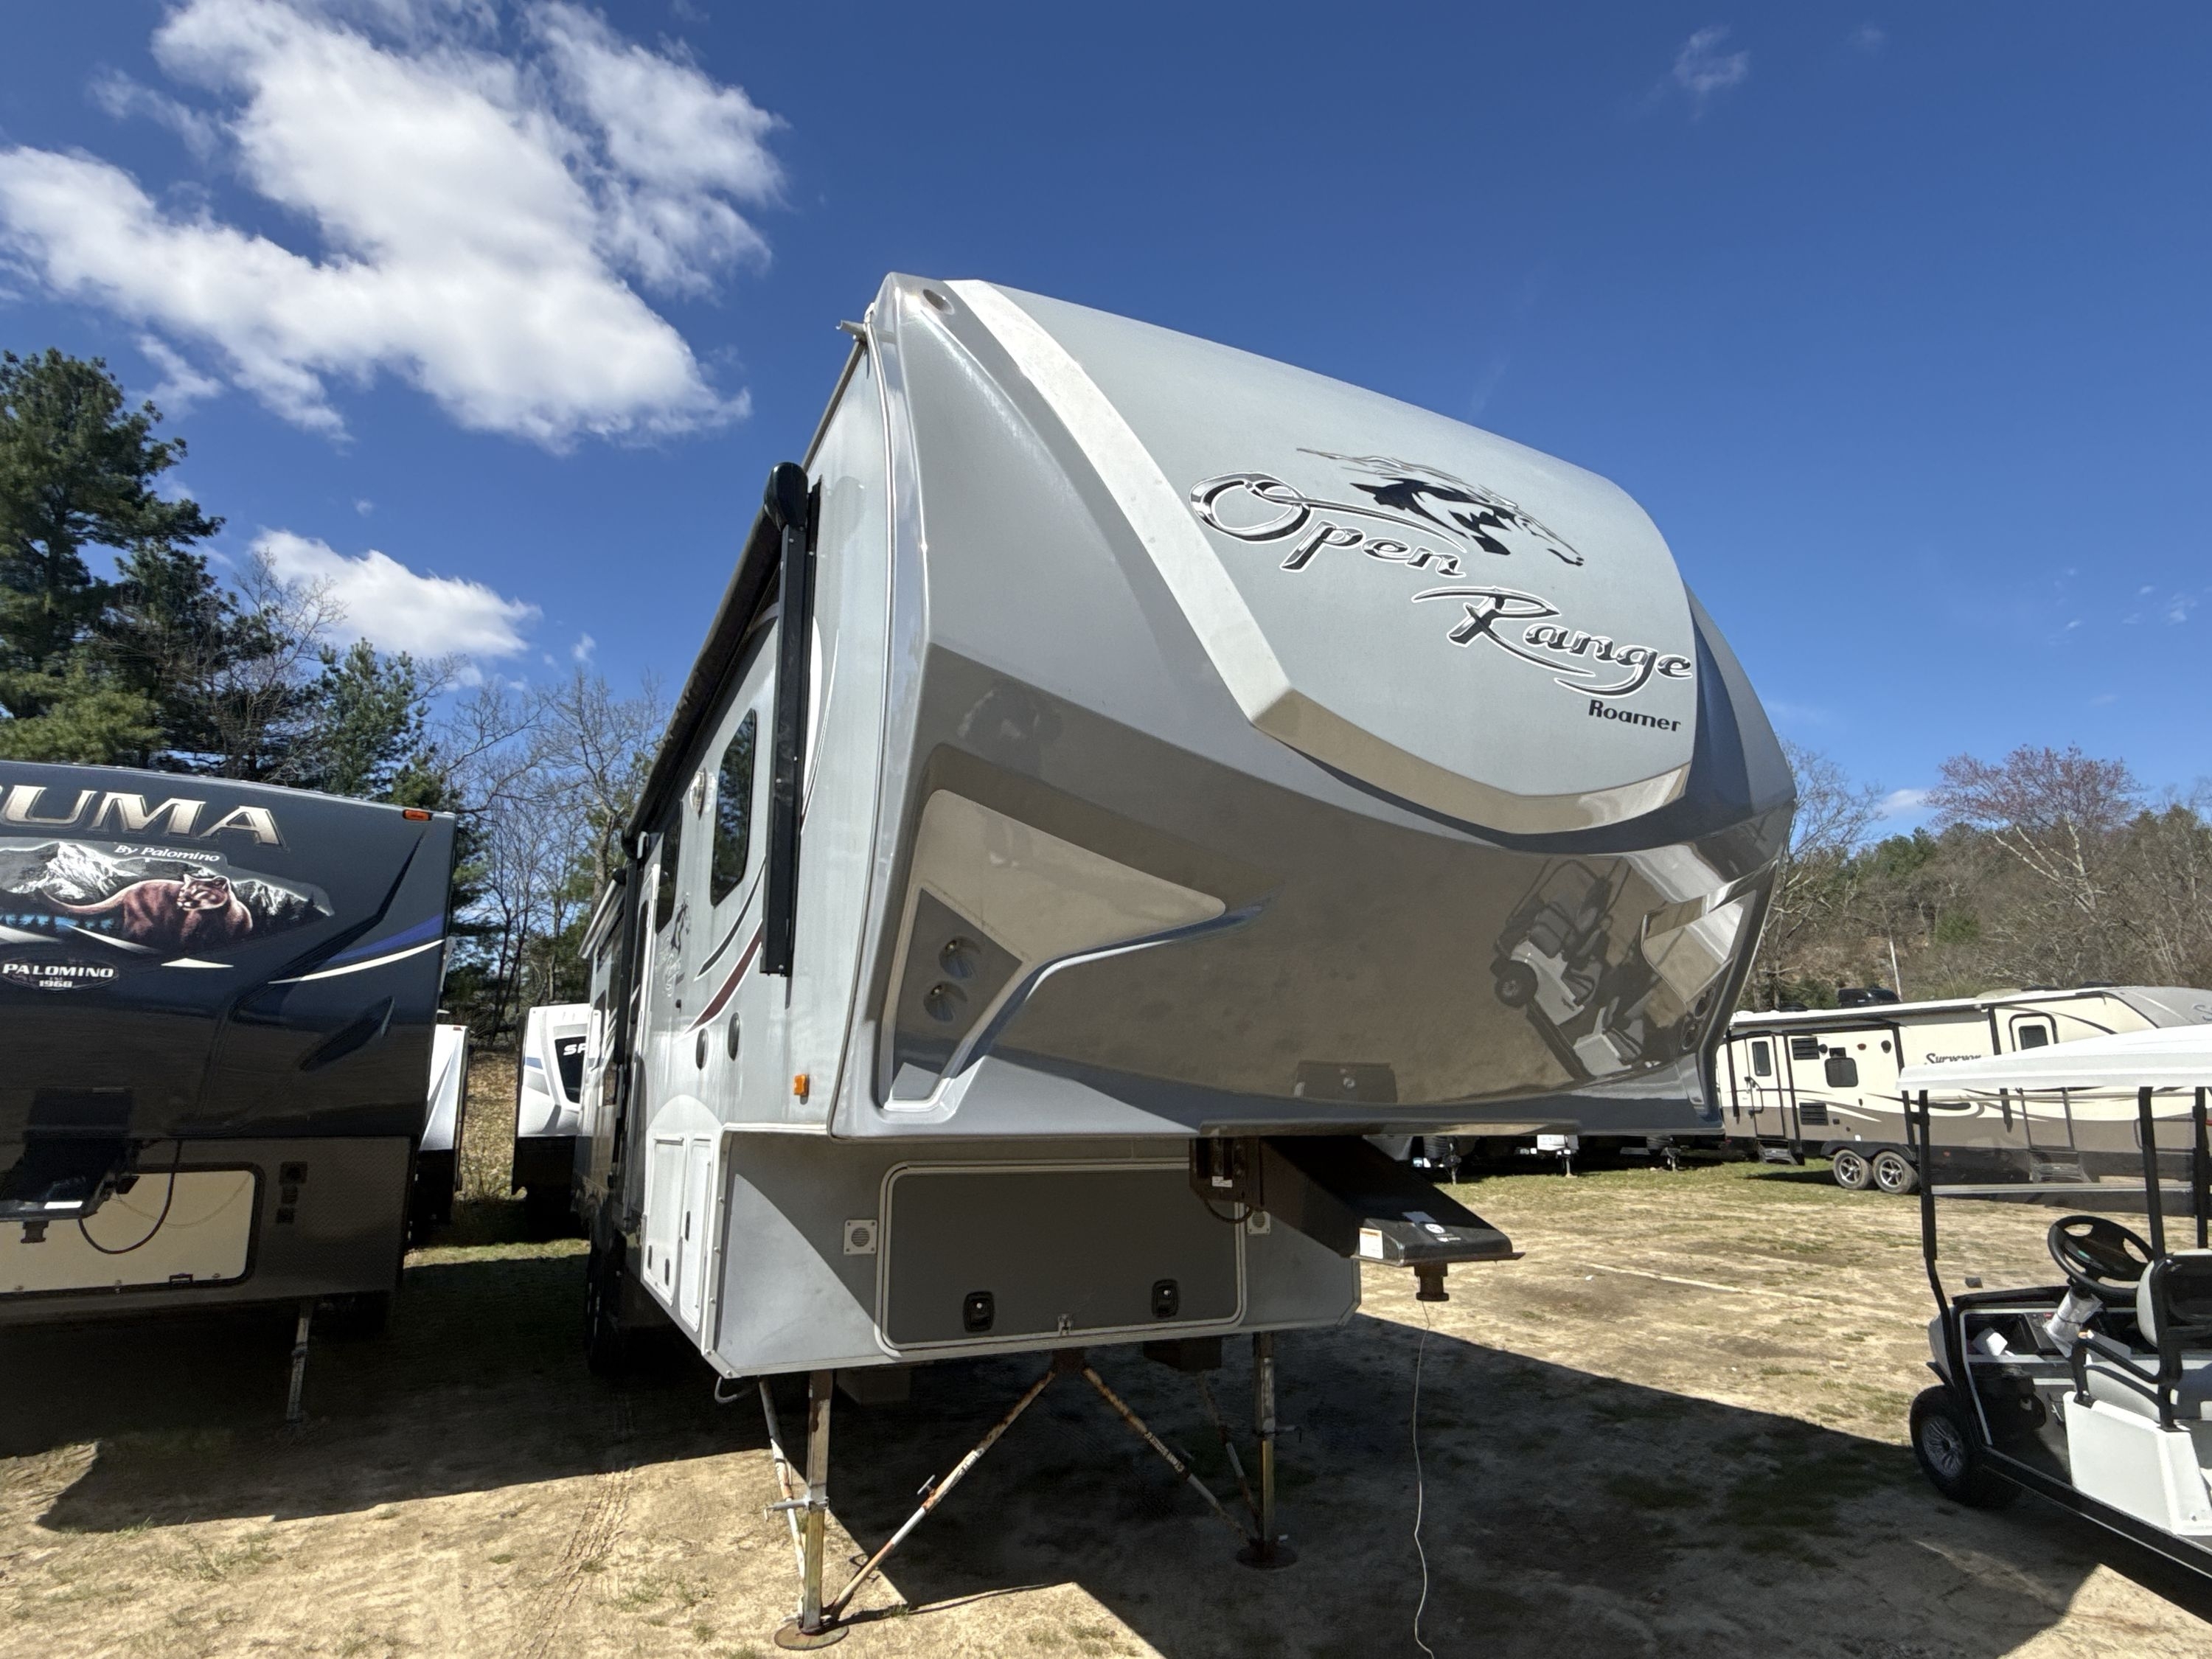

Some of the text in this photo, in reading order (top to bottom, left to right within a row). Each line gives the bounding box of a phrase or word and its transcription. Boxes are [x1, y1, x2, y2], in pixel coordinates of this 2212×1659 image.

[1189, 471, 1467, 578] Open
[1411, 585, 1693, 698] Range
[1588, 699, 1681, 731] Roamer
[0, 785, 283, 846] UMA
[114, 845, 220, 862] By Palomino
[2, 964, 114, 978] PALOMINO
[39, 980, 73, 988] 1968
